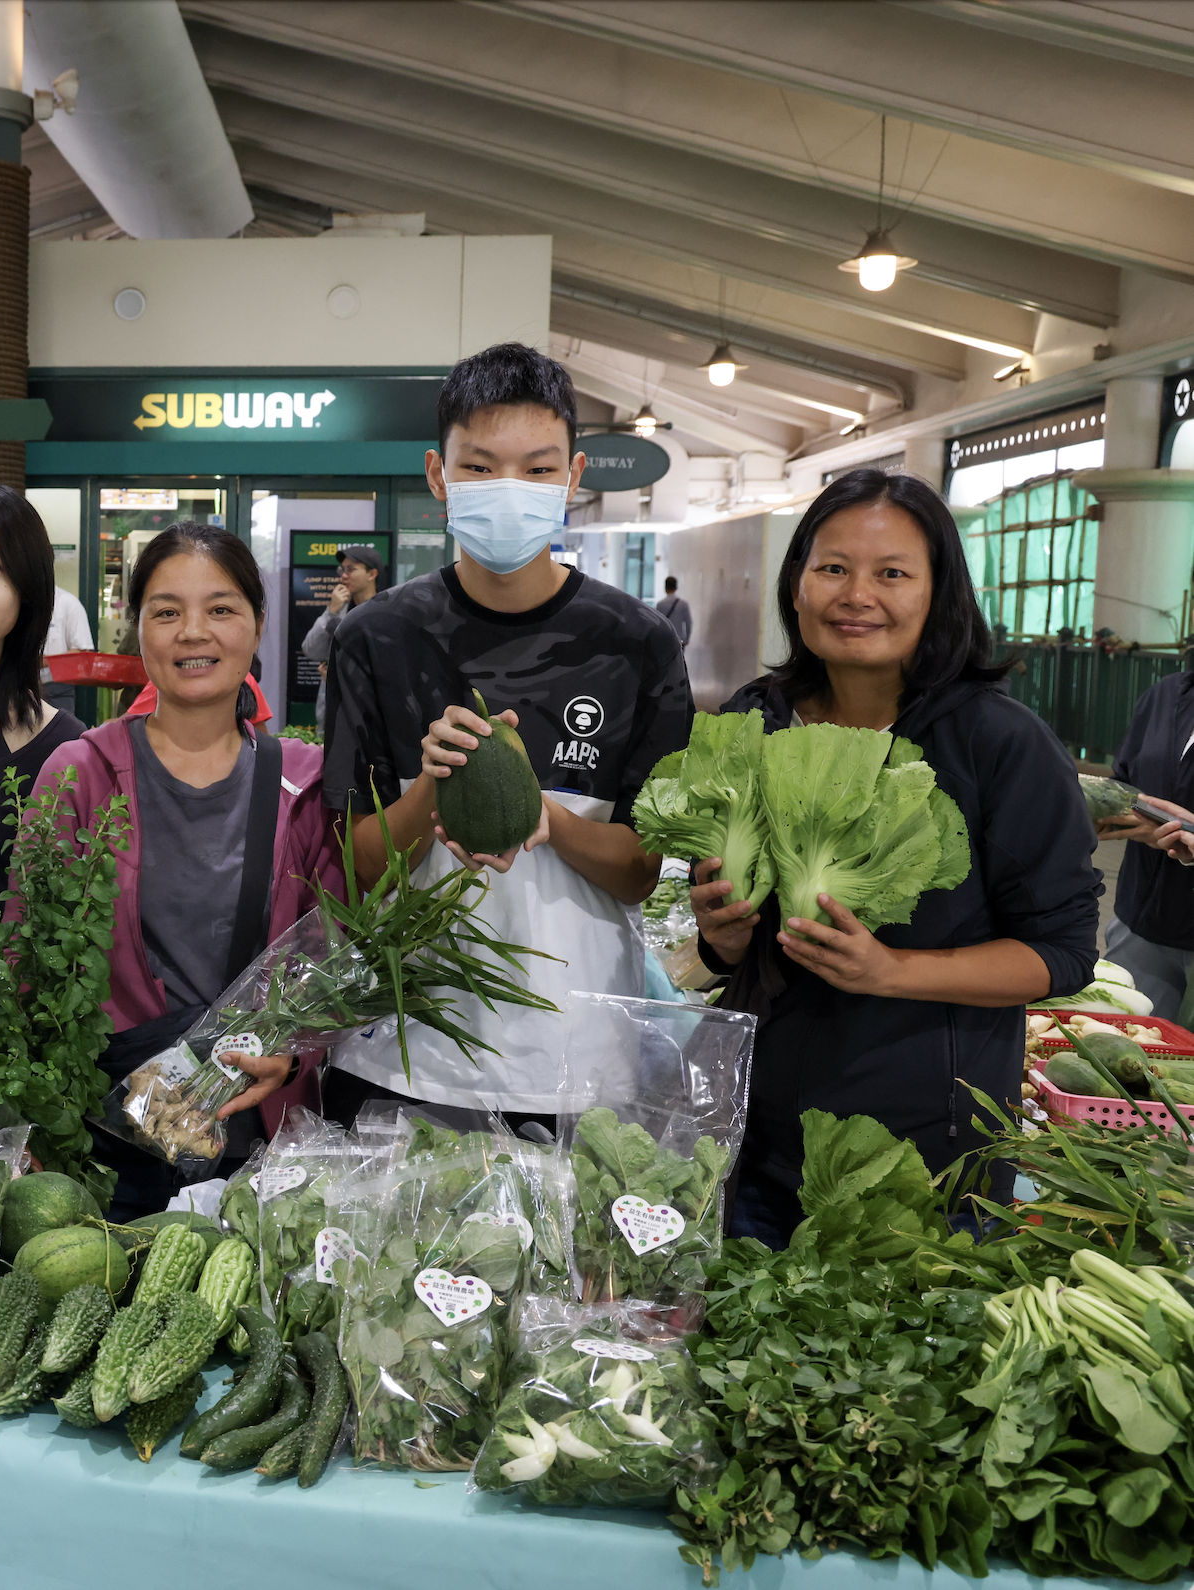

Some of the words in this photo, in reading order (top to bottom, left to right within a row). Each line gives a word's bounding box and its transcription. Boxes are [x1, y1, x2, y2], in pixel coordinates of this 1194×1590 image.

[133, 388, 337, 431] SUBWAY
[307, 542, 375, 556] SUB
[551, 740, 600, 770] AAPE
[629, 1208, 669, 1225] 益生有機農場
[432, 1282, 475, 1295] 益生有機農場
